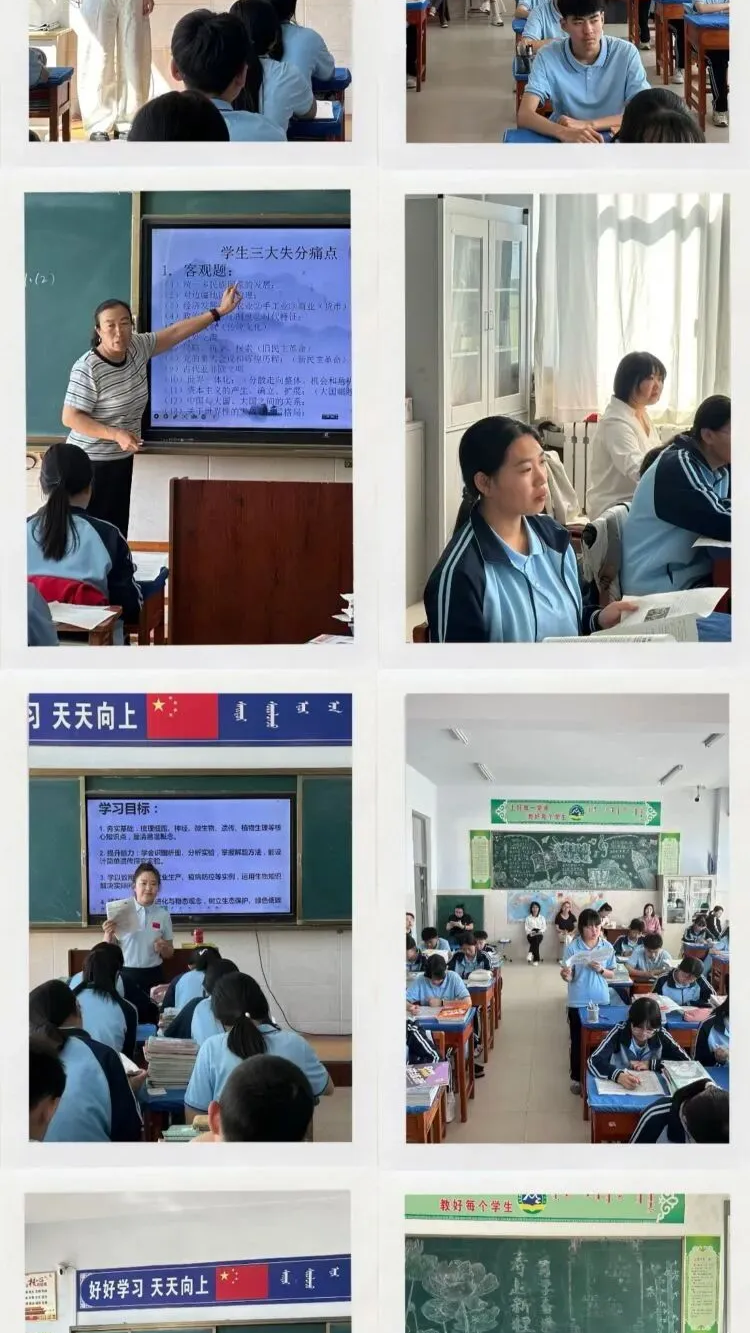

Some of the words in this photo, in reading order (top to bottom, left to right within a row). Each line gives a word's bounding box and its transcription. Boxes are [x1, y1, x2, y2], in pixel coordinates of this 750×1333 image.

[221, 245, 338, 260] 学生三大失分痛点
[52, 701, 138, 730] 天天向上
[99, 802, 159, 815] 学习目标：
[439, 1198, 513, 1213] 教好每个学生
[89, 1278, 144, 1300] 好好学习
[151, 1274, 209, 1297] 天天向上
